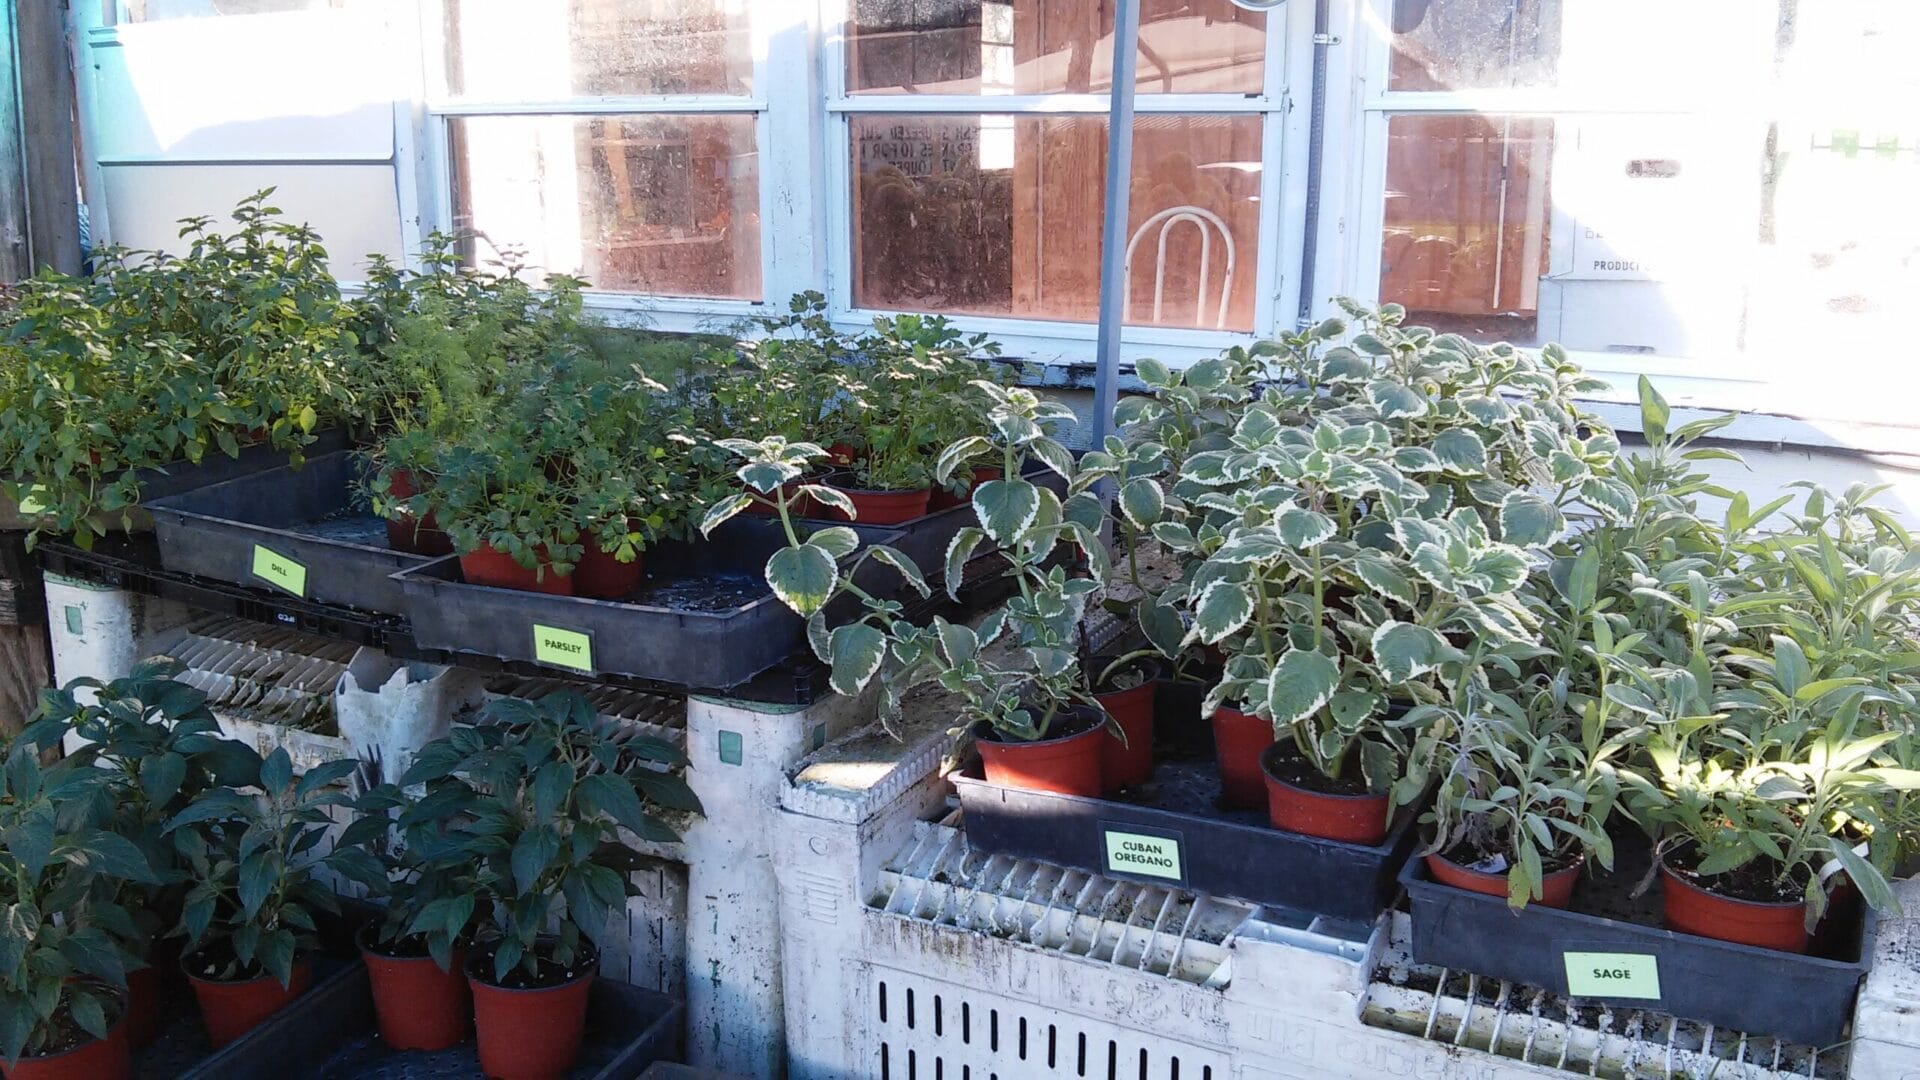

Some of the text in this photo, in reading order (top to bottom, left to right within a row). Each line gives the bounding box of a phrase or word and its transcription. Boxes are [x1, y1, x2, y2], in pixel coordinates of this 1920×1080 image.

[271, 563, 288, 577] DILL
[544, 639, 582, 654] PARSLEY
[1122, 841, 1162, 855] CUBAN
[1114, 852, 1173, 868] OREGANO
[1592, 968, 1632, 980] SAGE
